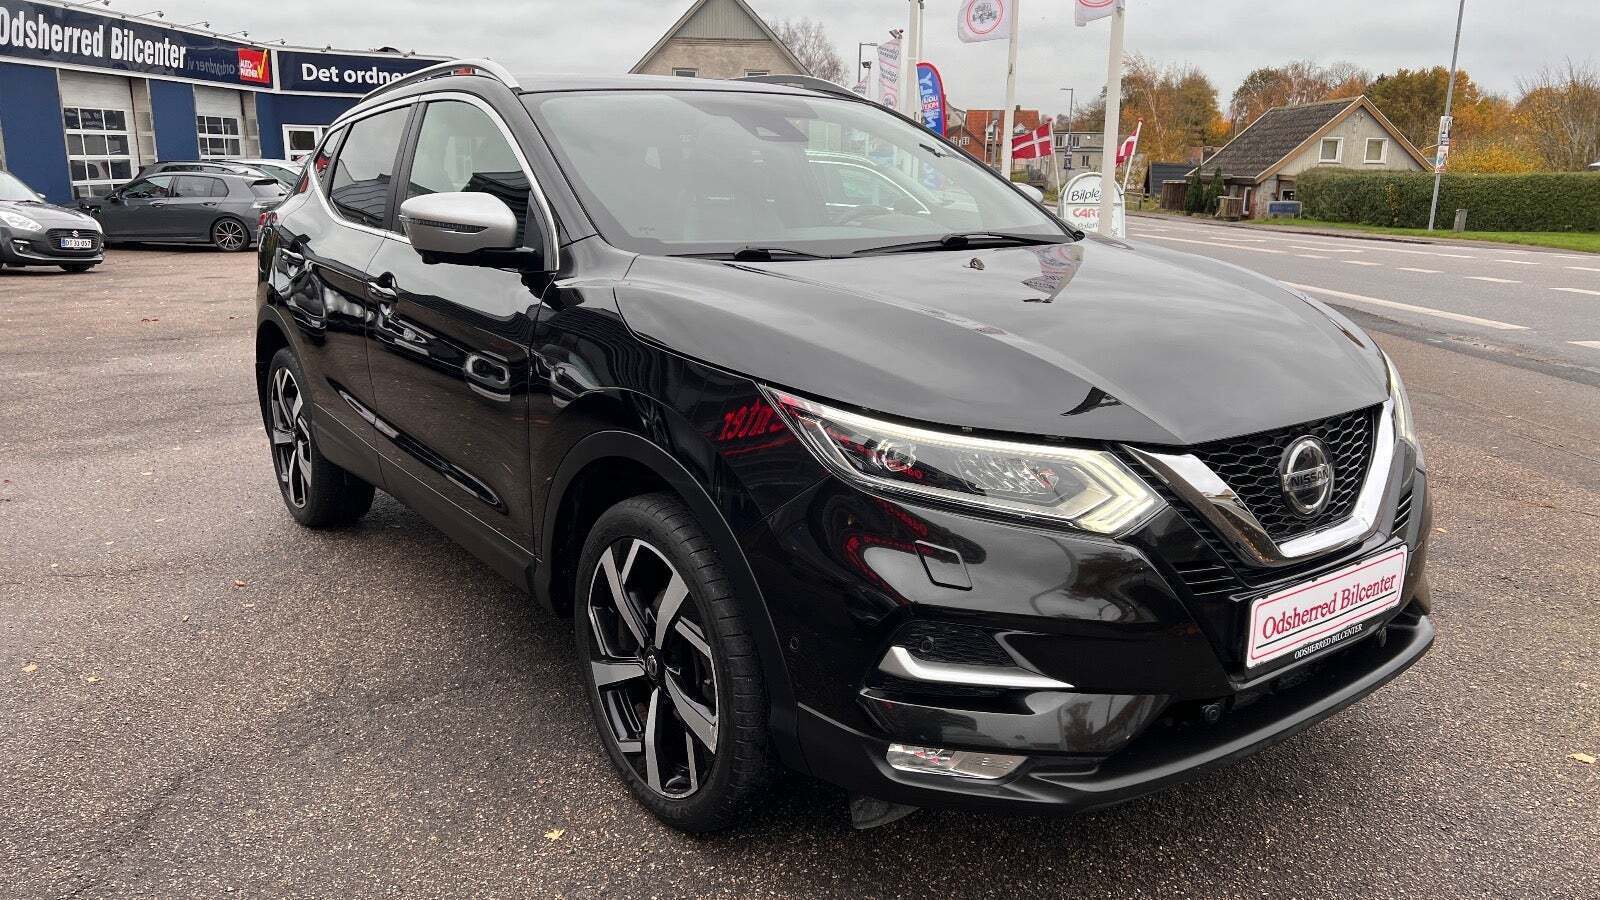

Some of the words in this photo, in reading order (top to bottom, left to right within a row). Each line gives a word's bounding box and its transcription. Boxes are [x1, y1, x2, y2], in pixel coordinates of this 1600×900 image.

[0, 6, 104, 58] Odsherred
[110, 27, 187, 69] Bilcenter
[301, 63, 339, 82] Det
[343, 67, 408, 85] ordne
[1071, 187, 1101, 203] Bilple
[1288, 467, 1329, 489] NISSAN
[1262, 592, 1337, 640] Odsherred
[1340, 574, 1397, 610] Bilcenter
[1294, 637, 1331, 660] ODSHERRED
[1331, 623, 1363, 645] BILCENTER
